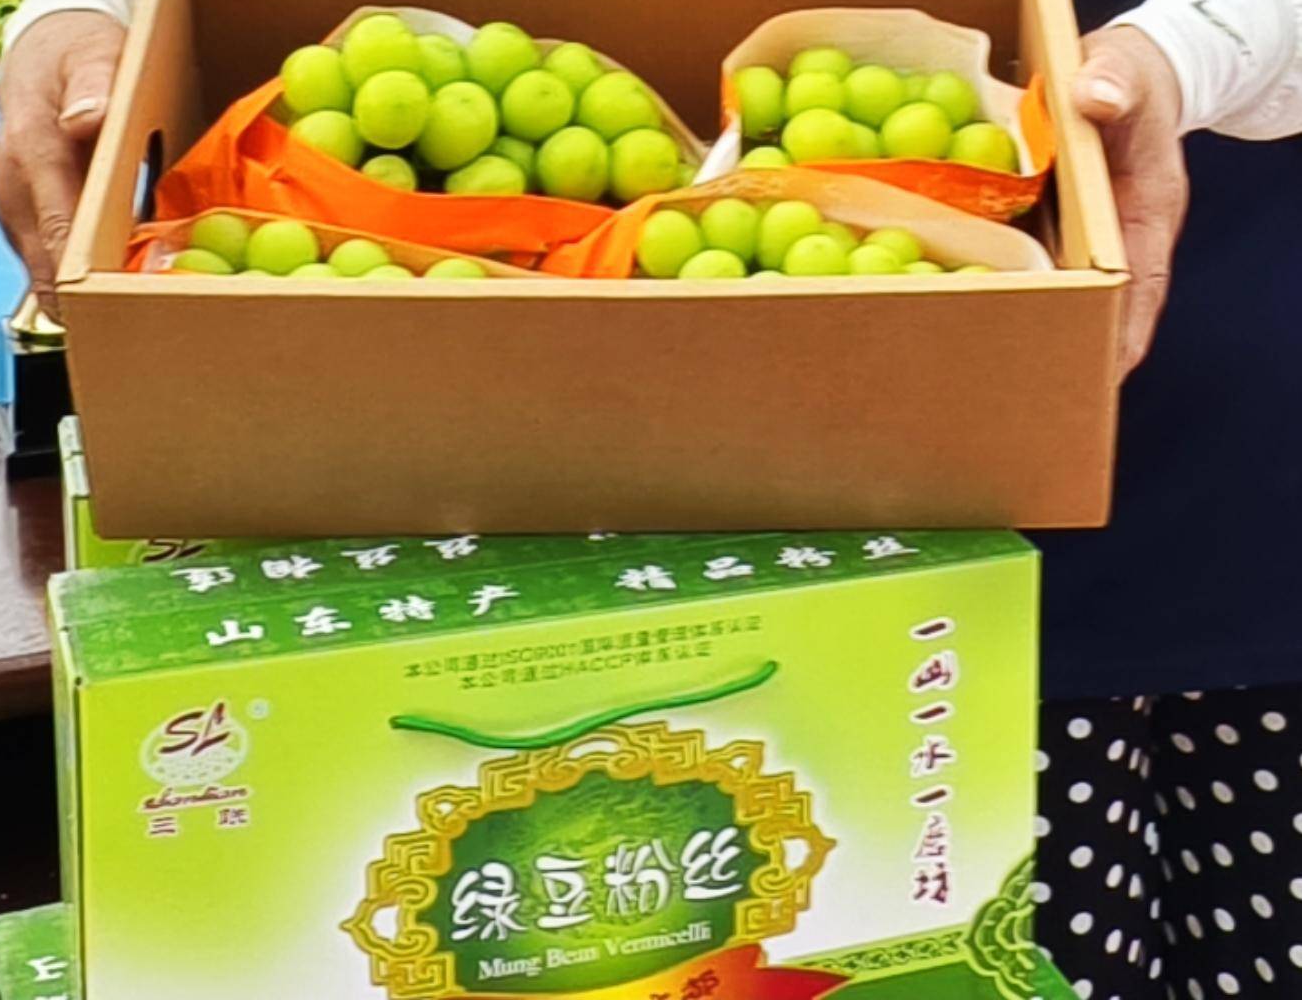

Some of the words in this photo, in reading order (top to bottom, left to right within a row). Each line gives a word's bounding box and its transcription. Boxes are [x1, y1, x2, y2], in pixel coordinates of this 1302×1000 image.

[614, 535, 921, 591] 精品粉丝
[207, 584, 520, 648] 山东特产
[450, 826, 745, 941] 绿豆粉丝
[478, 958, 543, 981] Mung
[546, 945, 599, 969] Bean
[605, 919, 713, 957] Vermicelli
